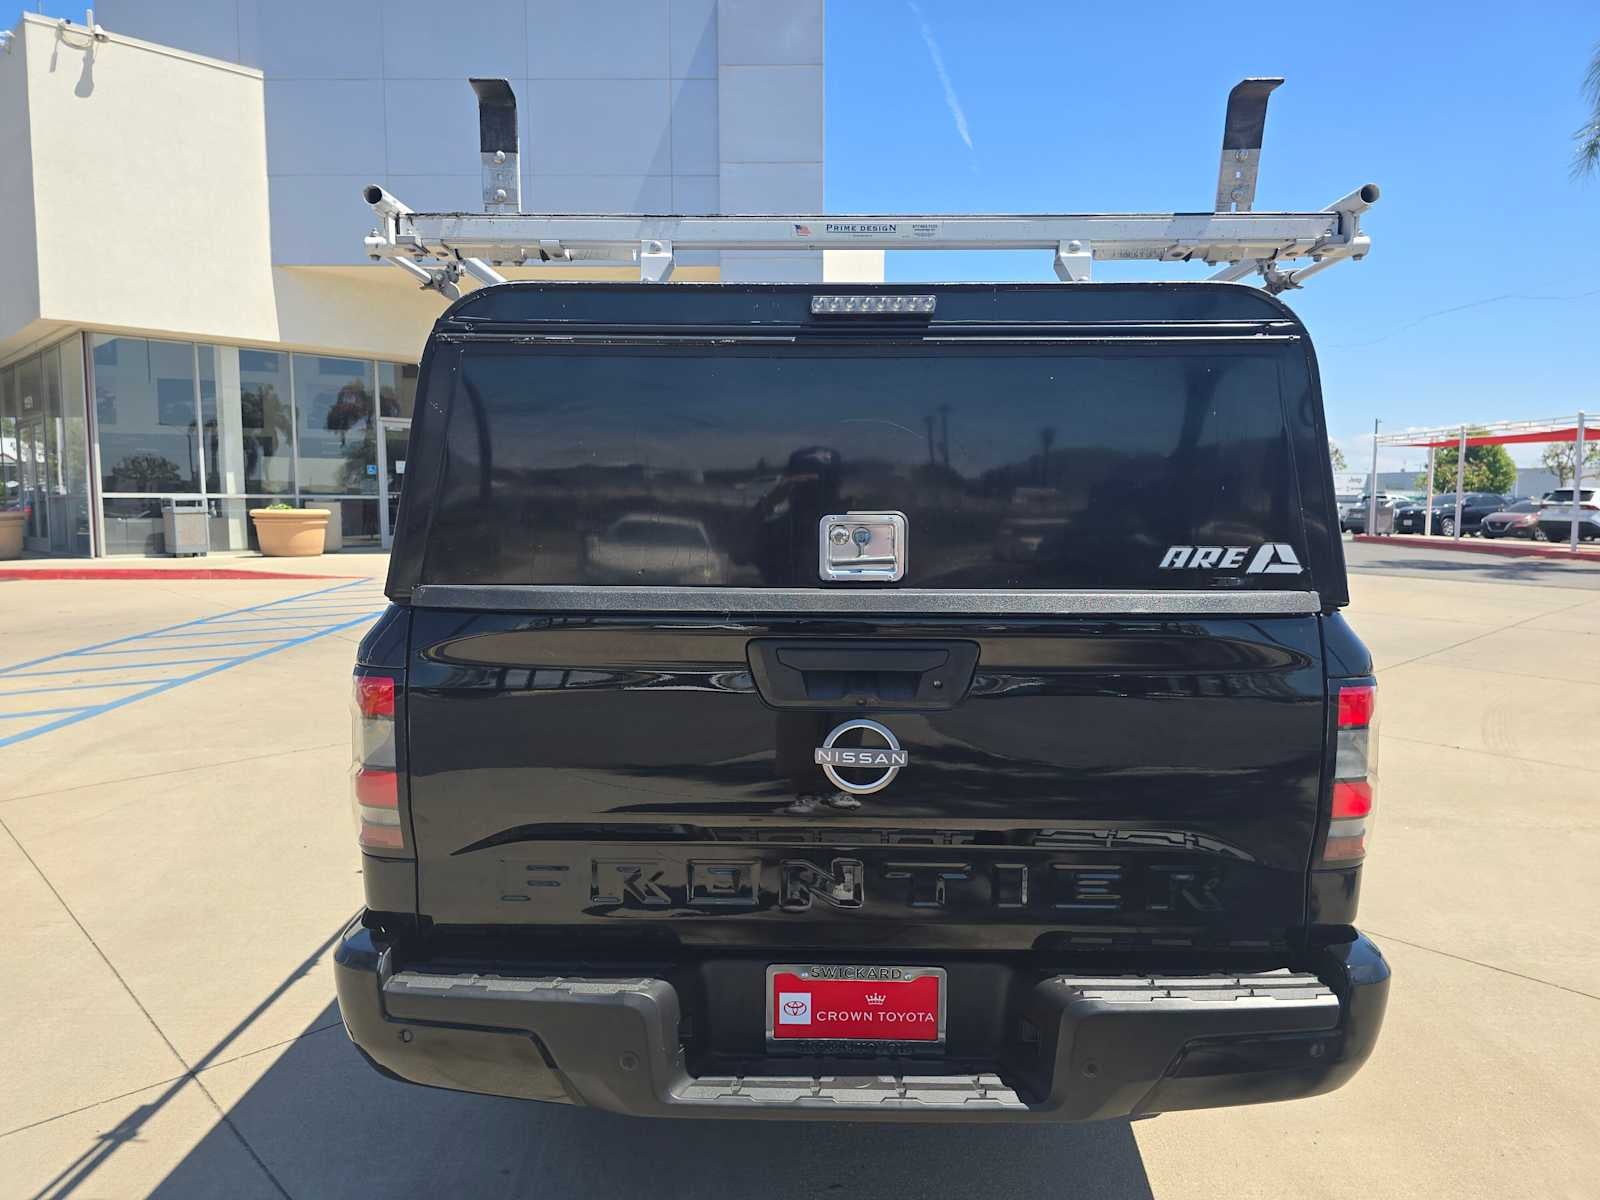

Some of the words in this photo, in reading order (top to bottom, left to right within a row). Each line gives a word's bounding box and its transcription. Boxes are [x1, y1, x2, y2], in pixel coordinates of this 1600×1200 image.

[1159, 546, 1250, 569] ARE
[817, 750, 905, 764] NISSAN
[499, 858, 1224, 911] FRONTIER
[811, 967, 903, 980] SWICKARD
[816, 1011, 873, 1022] CROWN
[878, 1011, 935, 1023] TOYOTA
